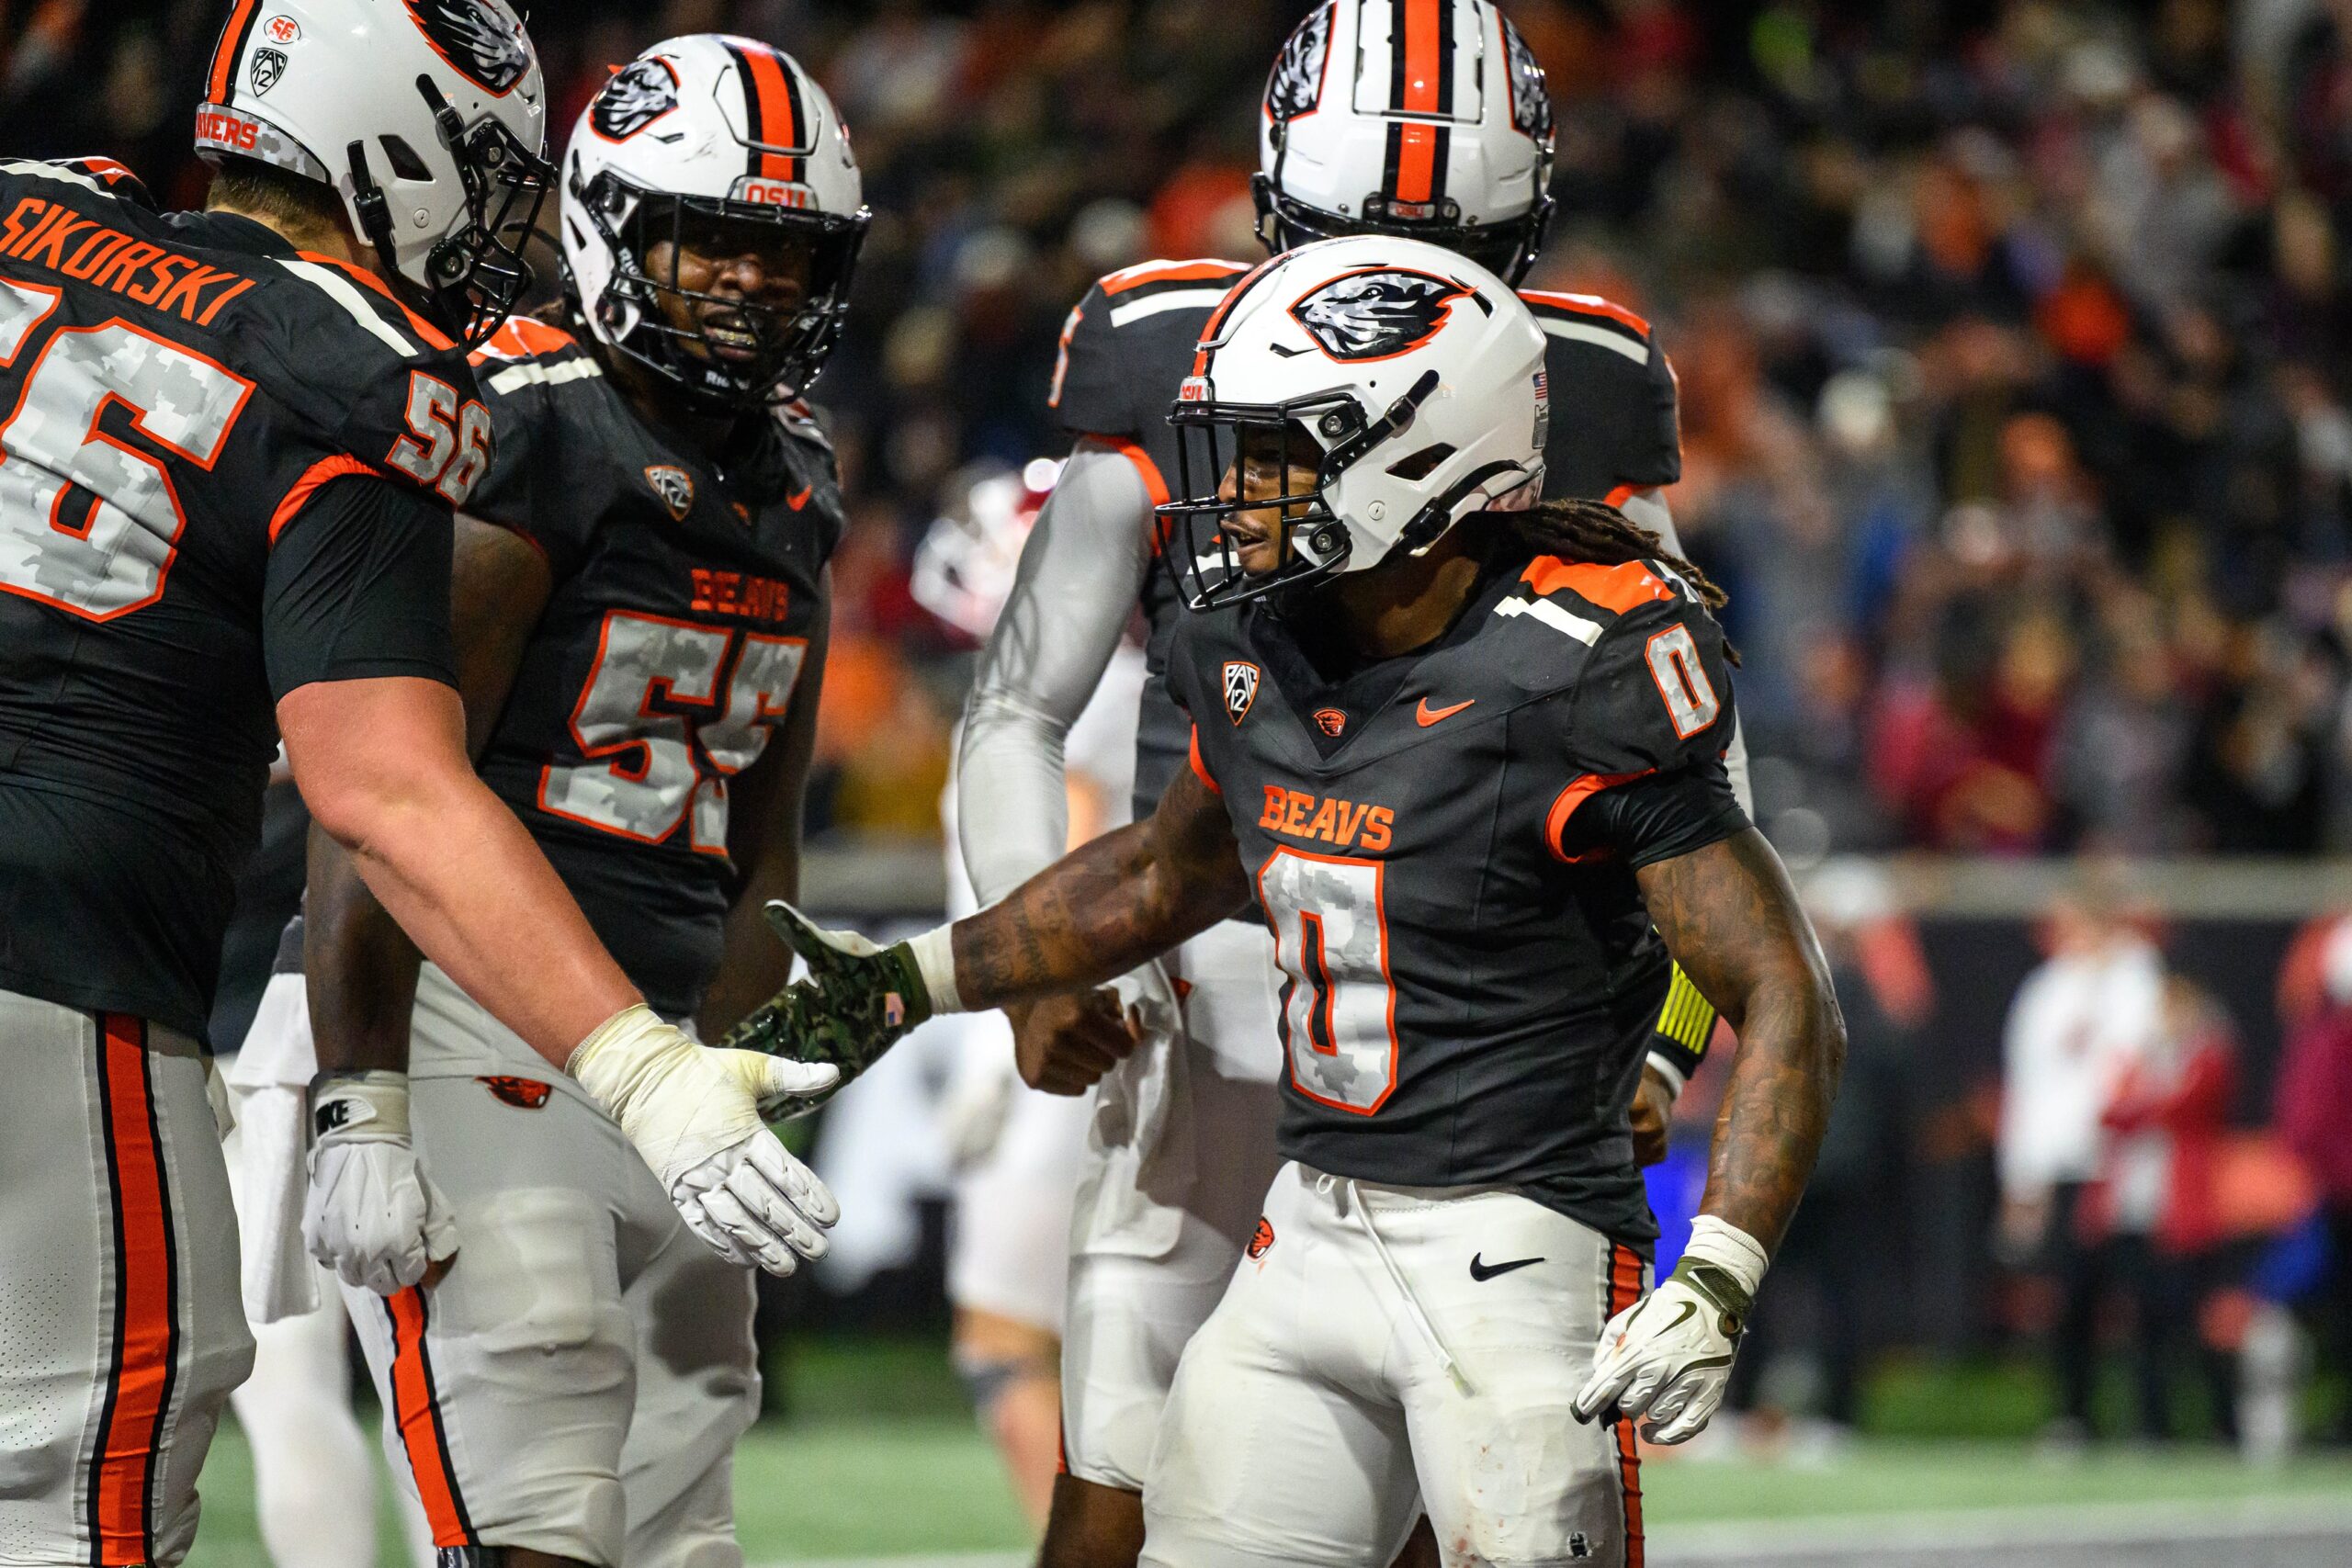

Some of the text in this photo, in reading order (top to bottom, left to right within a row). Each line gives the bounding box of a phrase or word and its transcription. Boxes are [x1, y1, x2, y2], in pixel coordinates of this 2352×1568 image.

[253, 50, 285, 81] PAC
[254, 69, 273, 87] 12
[0, 197, 257, 327] SIKORSKI
[384, 369, 492, 507] 56
[690, 569, 789, 622] BEAVS
[1225, 664, 1258, 703] PAC
[1230, 688, 1247, 712] 12
[1644, 622, 1721, 740] 0
[1258, 784, 1396, 852] BEAVS
[1257, 844, 1398, 1117] 0
